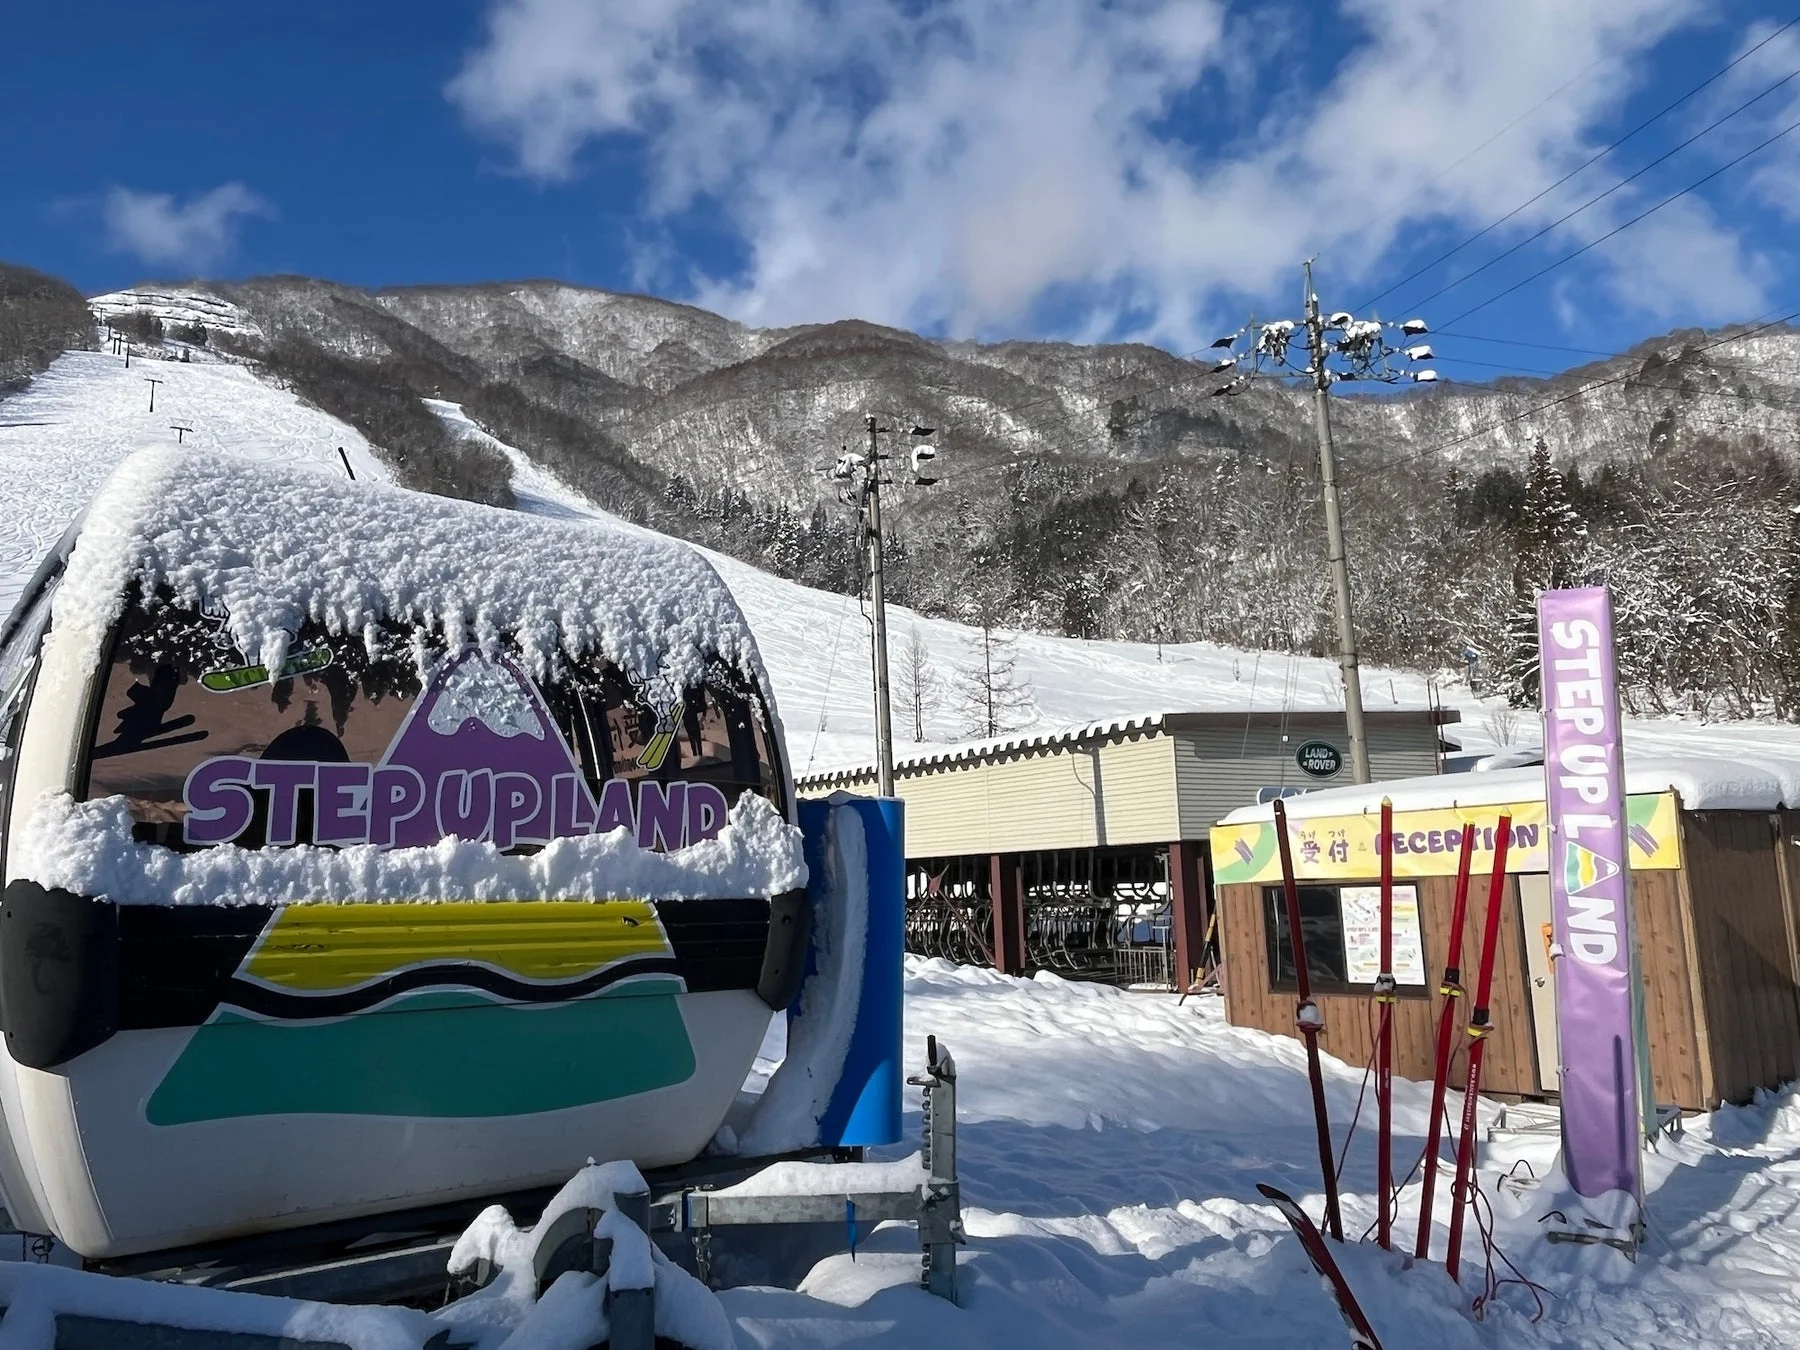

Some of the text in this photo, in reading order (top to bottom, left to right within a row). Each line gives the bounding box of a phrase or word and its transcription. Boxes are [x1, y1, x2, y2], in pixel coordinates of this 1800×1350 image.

[1305, 747, 1328, 759] LAND
[1308, 759, 1336, 771] ROVER
[183, 755, 728, 853] STEP UP LAND
[1550, 618, 1620, 966] STEP UP LAND
[1300, 839, 1349, 864] 受付
[1374, 823, 1539, 856] ECEPIN
